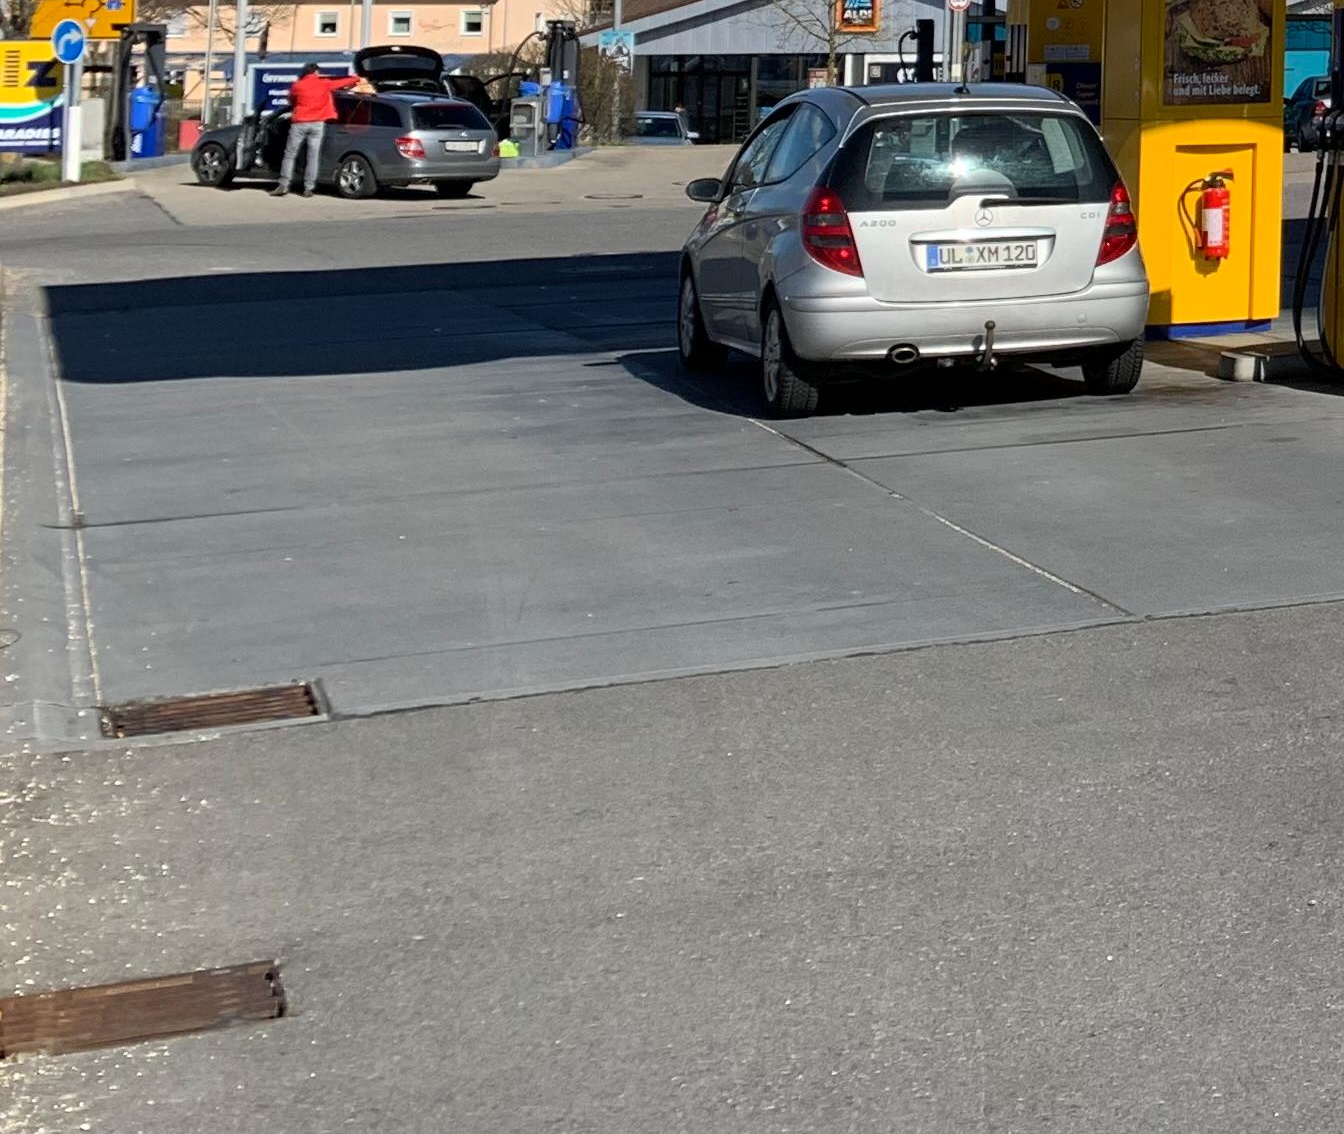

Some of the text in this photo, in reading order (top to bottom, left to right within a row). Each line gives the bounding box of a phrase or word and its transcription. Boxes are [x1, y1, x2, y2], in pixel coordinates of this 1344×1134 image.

[843, 9, 873, 19] ALDI
[1173, 72, 1229, 85] Frisch, lecker
[1173, 86, 1191, 97] und
[1191, 85, 1207, 96] mit
[1208, 85, 1232, 97] Liebe
[1080, 211, 1100, 219] CDI
[859, 219, 897, 228] A200
[939, 243, 1036, 264] UL XM 120
